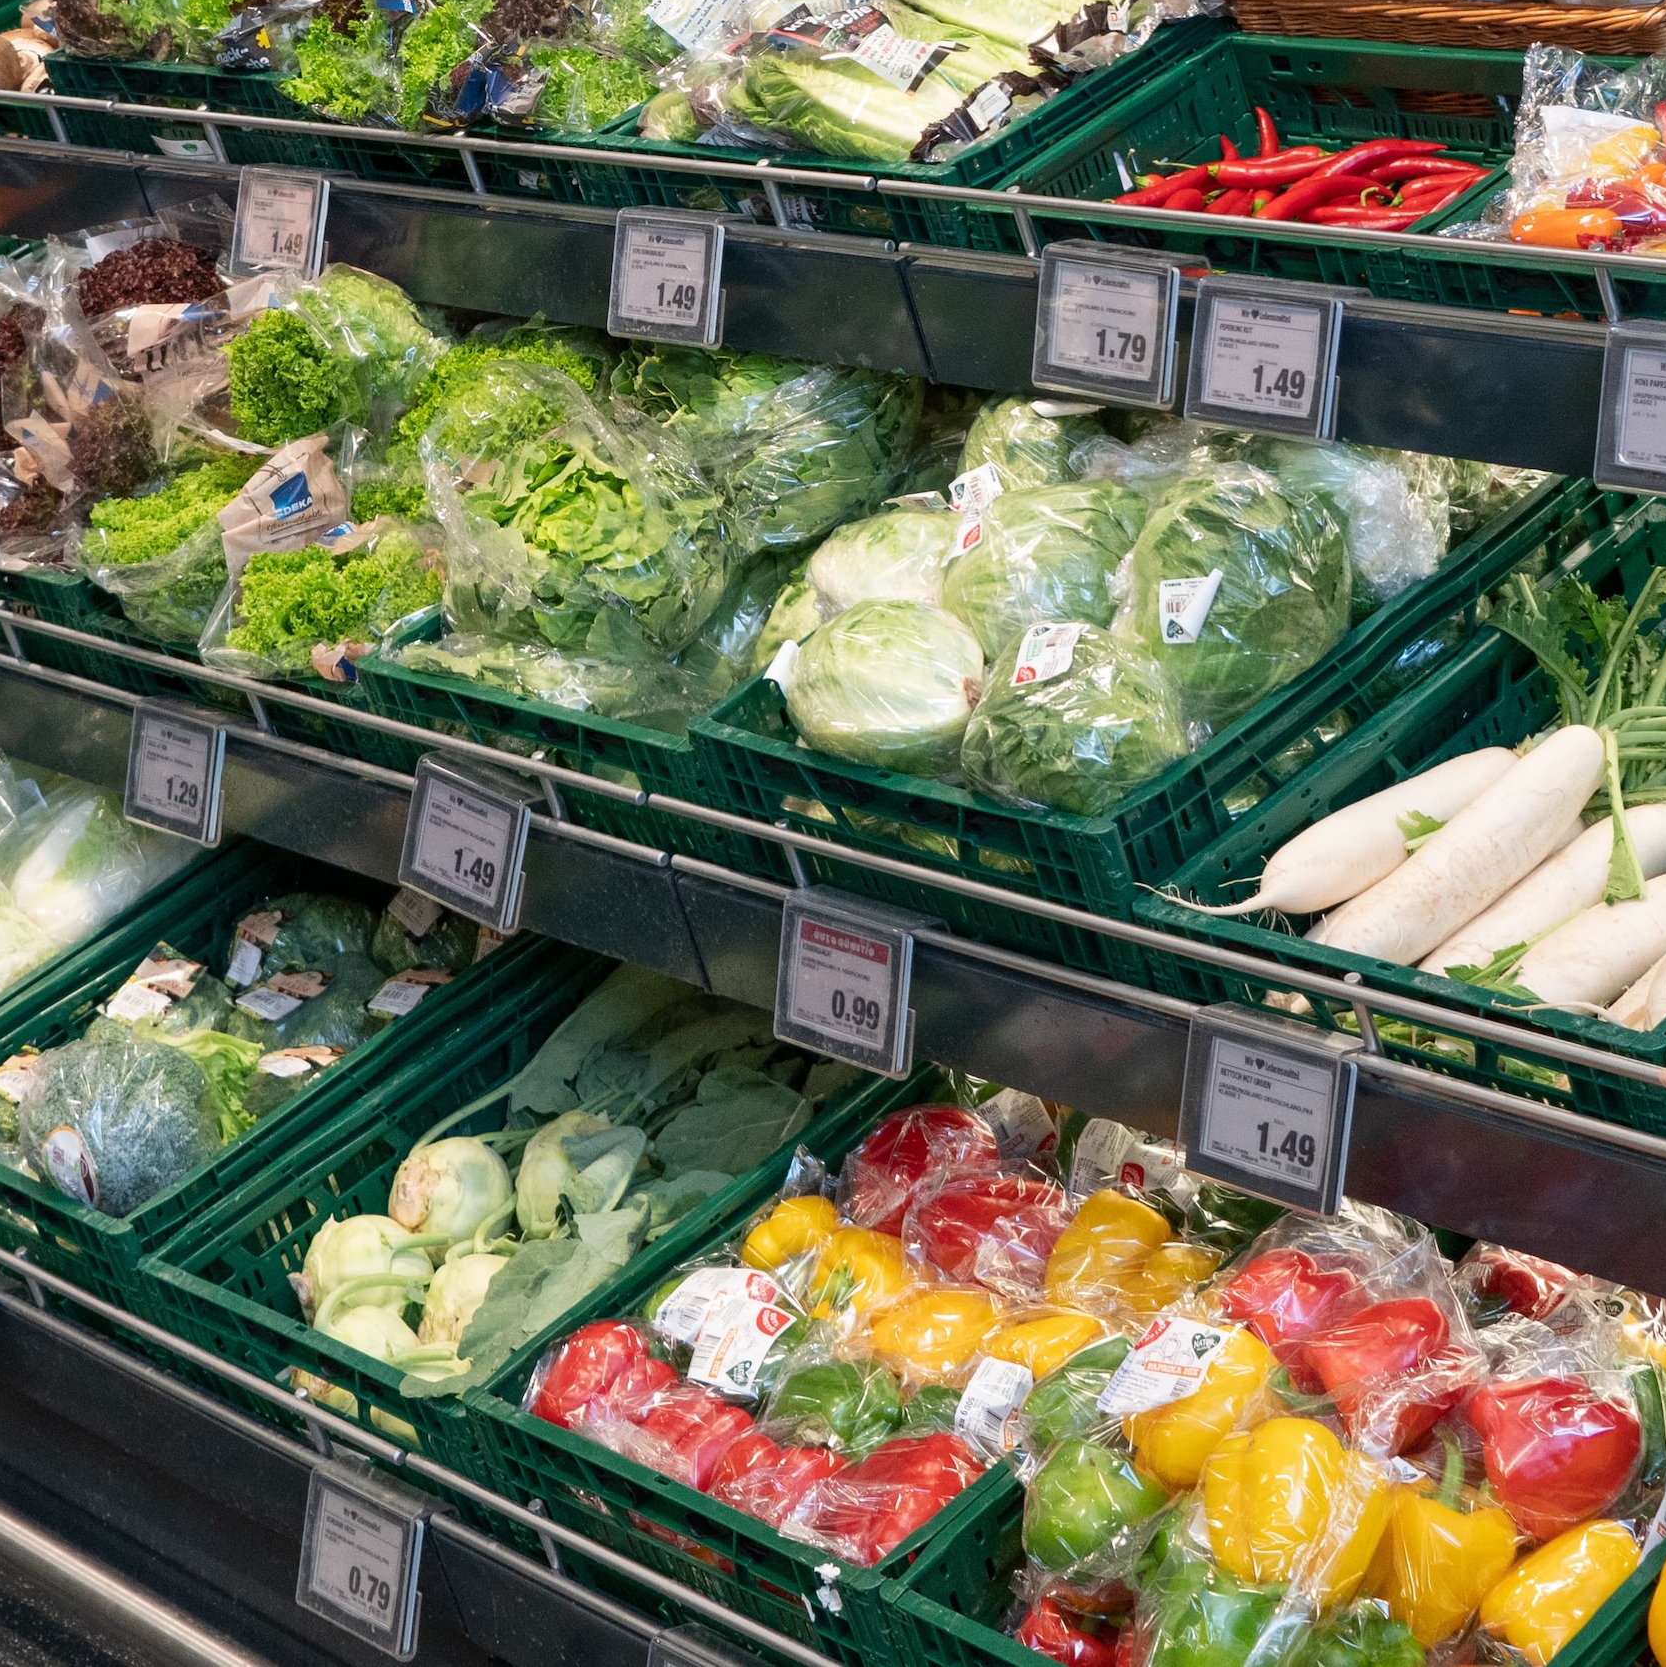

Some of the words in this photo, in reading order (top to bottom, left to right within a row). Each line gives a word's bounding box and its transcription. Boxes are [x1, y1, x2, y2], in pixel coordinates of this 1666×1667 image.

[271, 230, 304, 257] 1.49
[656, 281, 696, 312] 1.49
[1095, 327, 1147, 364] 1.79
[1251, 364, 1306, 400] 1.49
[1633, 380, 1649, 390] MINI
[274, 495, 314, 520] EDEKA
[166, 775, 198, 809] 1.29
[453, 847, 496, 889] 1.49
[831, 989, 881, 1031] 0.99
[1220, 1067, 1242, 1083] RETTICH
[1253, 1076, 1272, 1091] GRUEN
[1255, 1120, 1317, 1169] 1.49
[1147, 1361, 1182, 1375] PAPRIKA
[1183, 1366, 1201, 1378] MIX
[348, 1565, 391, 1612] 0.79
